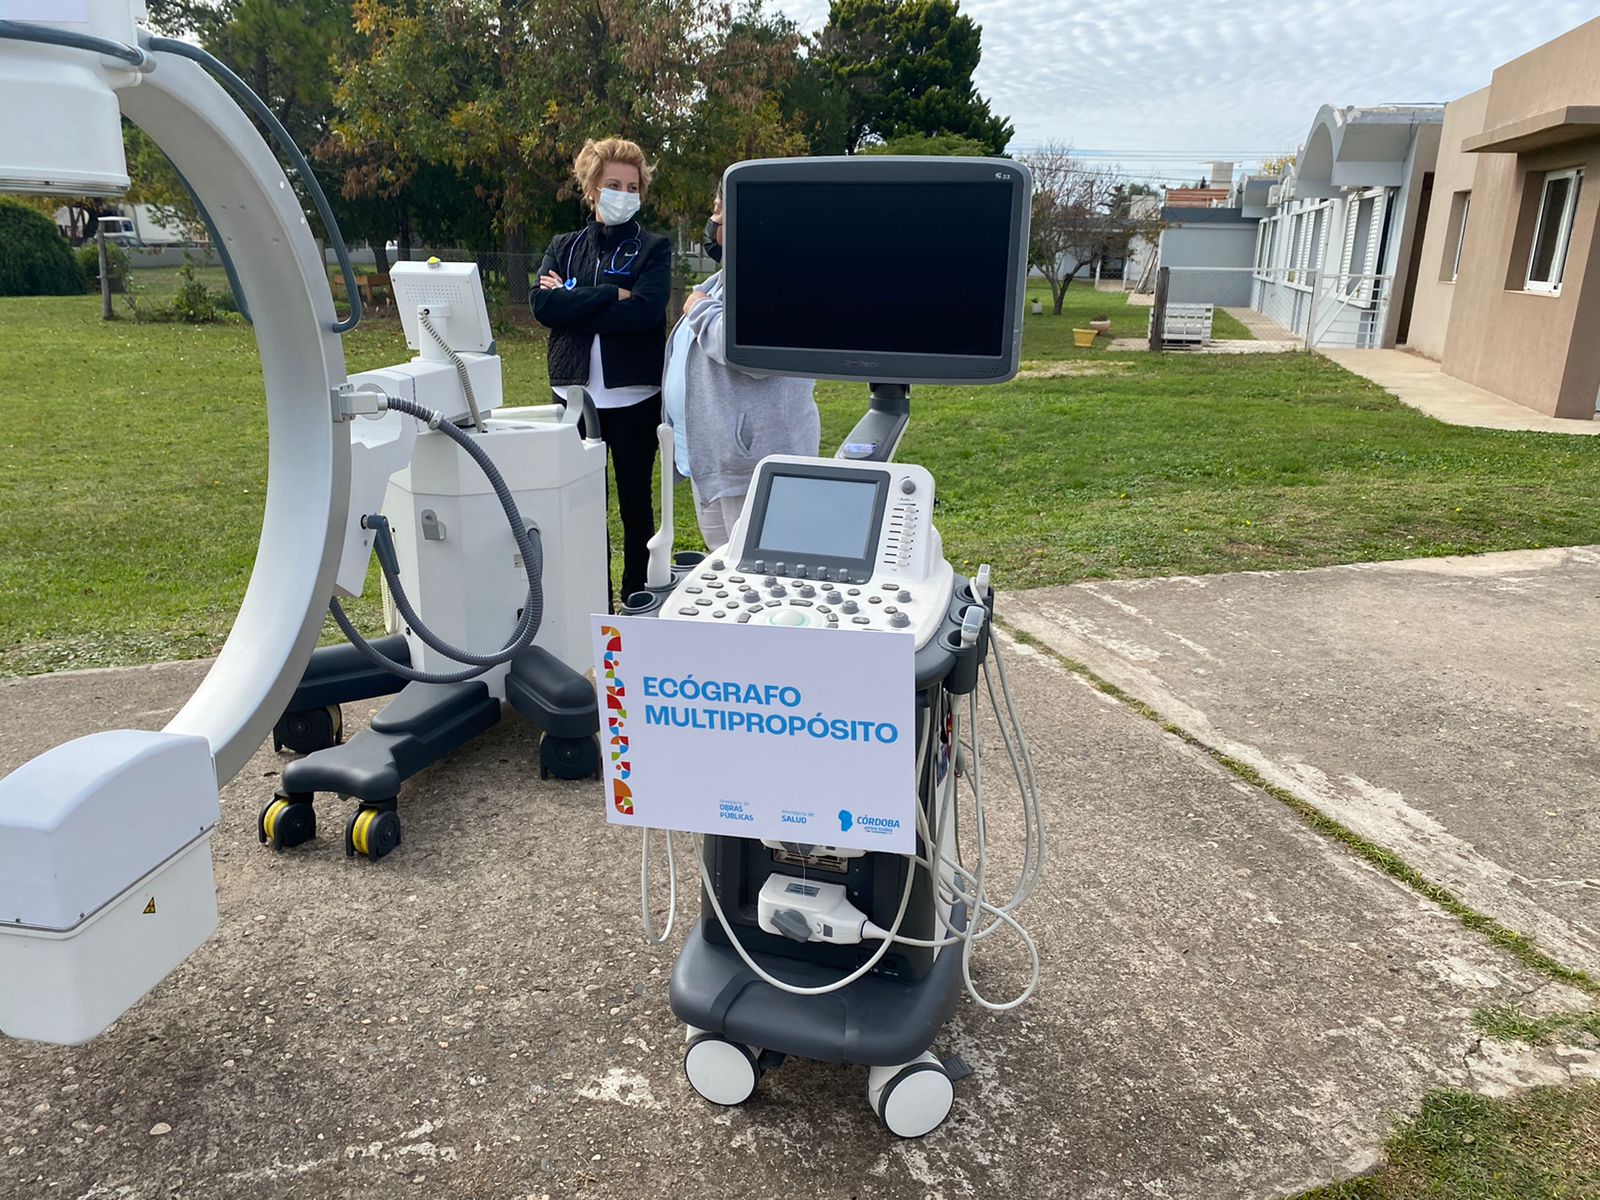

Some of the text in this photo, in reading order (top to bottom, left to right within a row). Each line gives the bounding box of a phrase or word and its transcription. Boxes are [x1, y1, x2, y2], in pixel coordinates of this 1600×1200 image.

[643, 674, 801, 708] ECÓGRAFO
[645, 705, 899, 744] MULTIPROPÓSITO
[719, 804, 744, 812] OBRAS
[720, 811, 754, 821] PÚBLICAS
[782, 815, 807, 824] SALUD
[857, 815, 900, 828] CÓRDOBA
